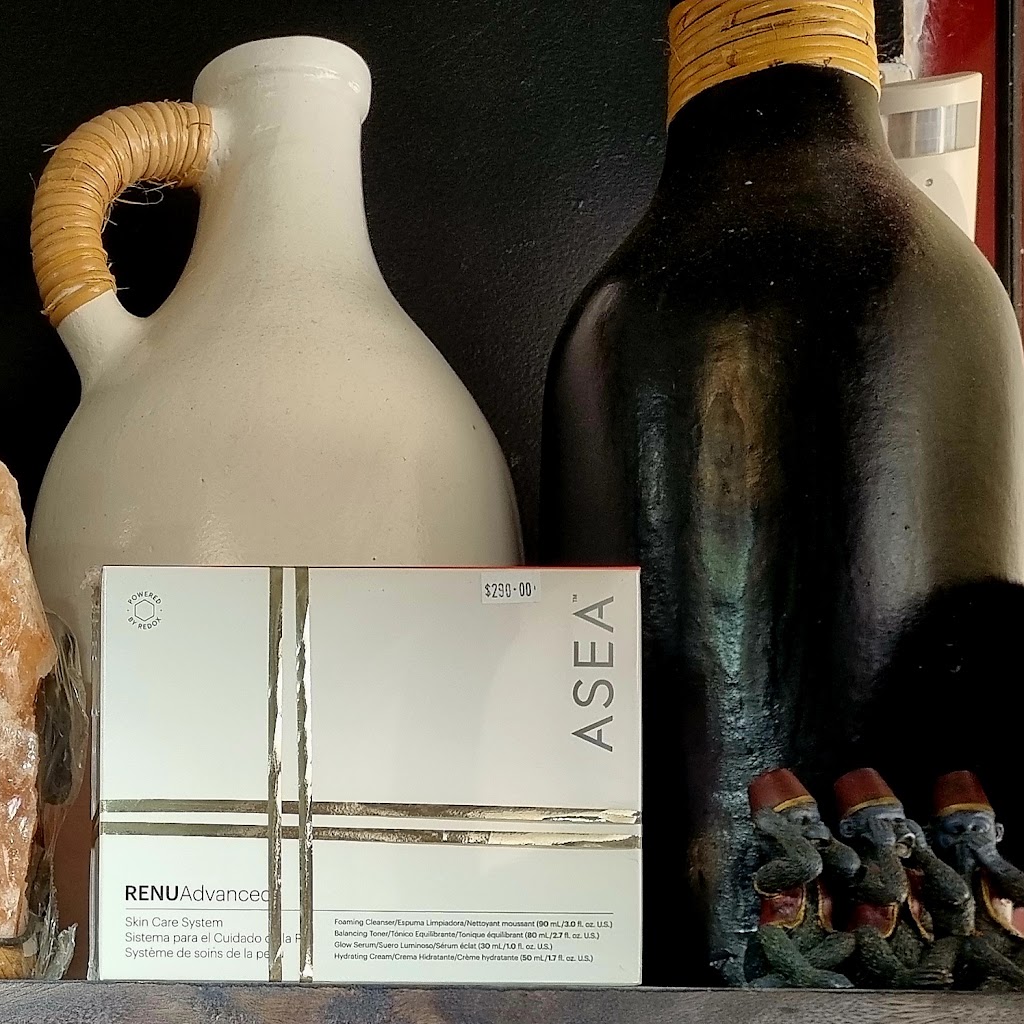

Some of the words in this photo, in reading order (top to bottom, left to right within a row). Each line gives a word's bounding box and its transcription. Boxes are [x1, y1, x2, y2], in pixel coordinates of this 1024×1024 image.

[127, 591, 162, 605] POWERED
[127, 616, 137, 626] BY
[137, 616, 162, 630] REDOX
[571, 595, 615, 753] ASEA
[125, 916, 149, 928] Skin
[151, 916, 179, 928] Care
[181, 917, 223, 930] System
[125, 932, 170, 943] Sistema
[173, 934, 198, 944] para
[201, 932, 211, 943] el
[214, 932, 261, 943] Cuidado
[334, 930, 368, 938] Balancing
[176, 947, 191, 959] de
[194, 946, 224, 958] soins
[226, 947, 240, 959] de
[243, 947, 253, 959] la
[334, 953, 368, 961] Hydrating
